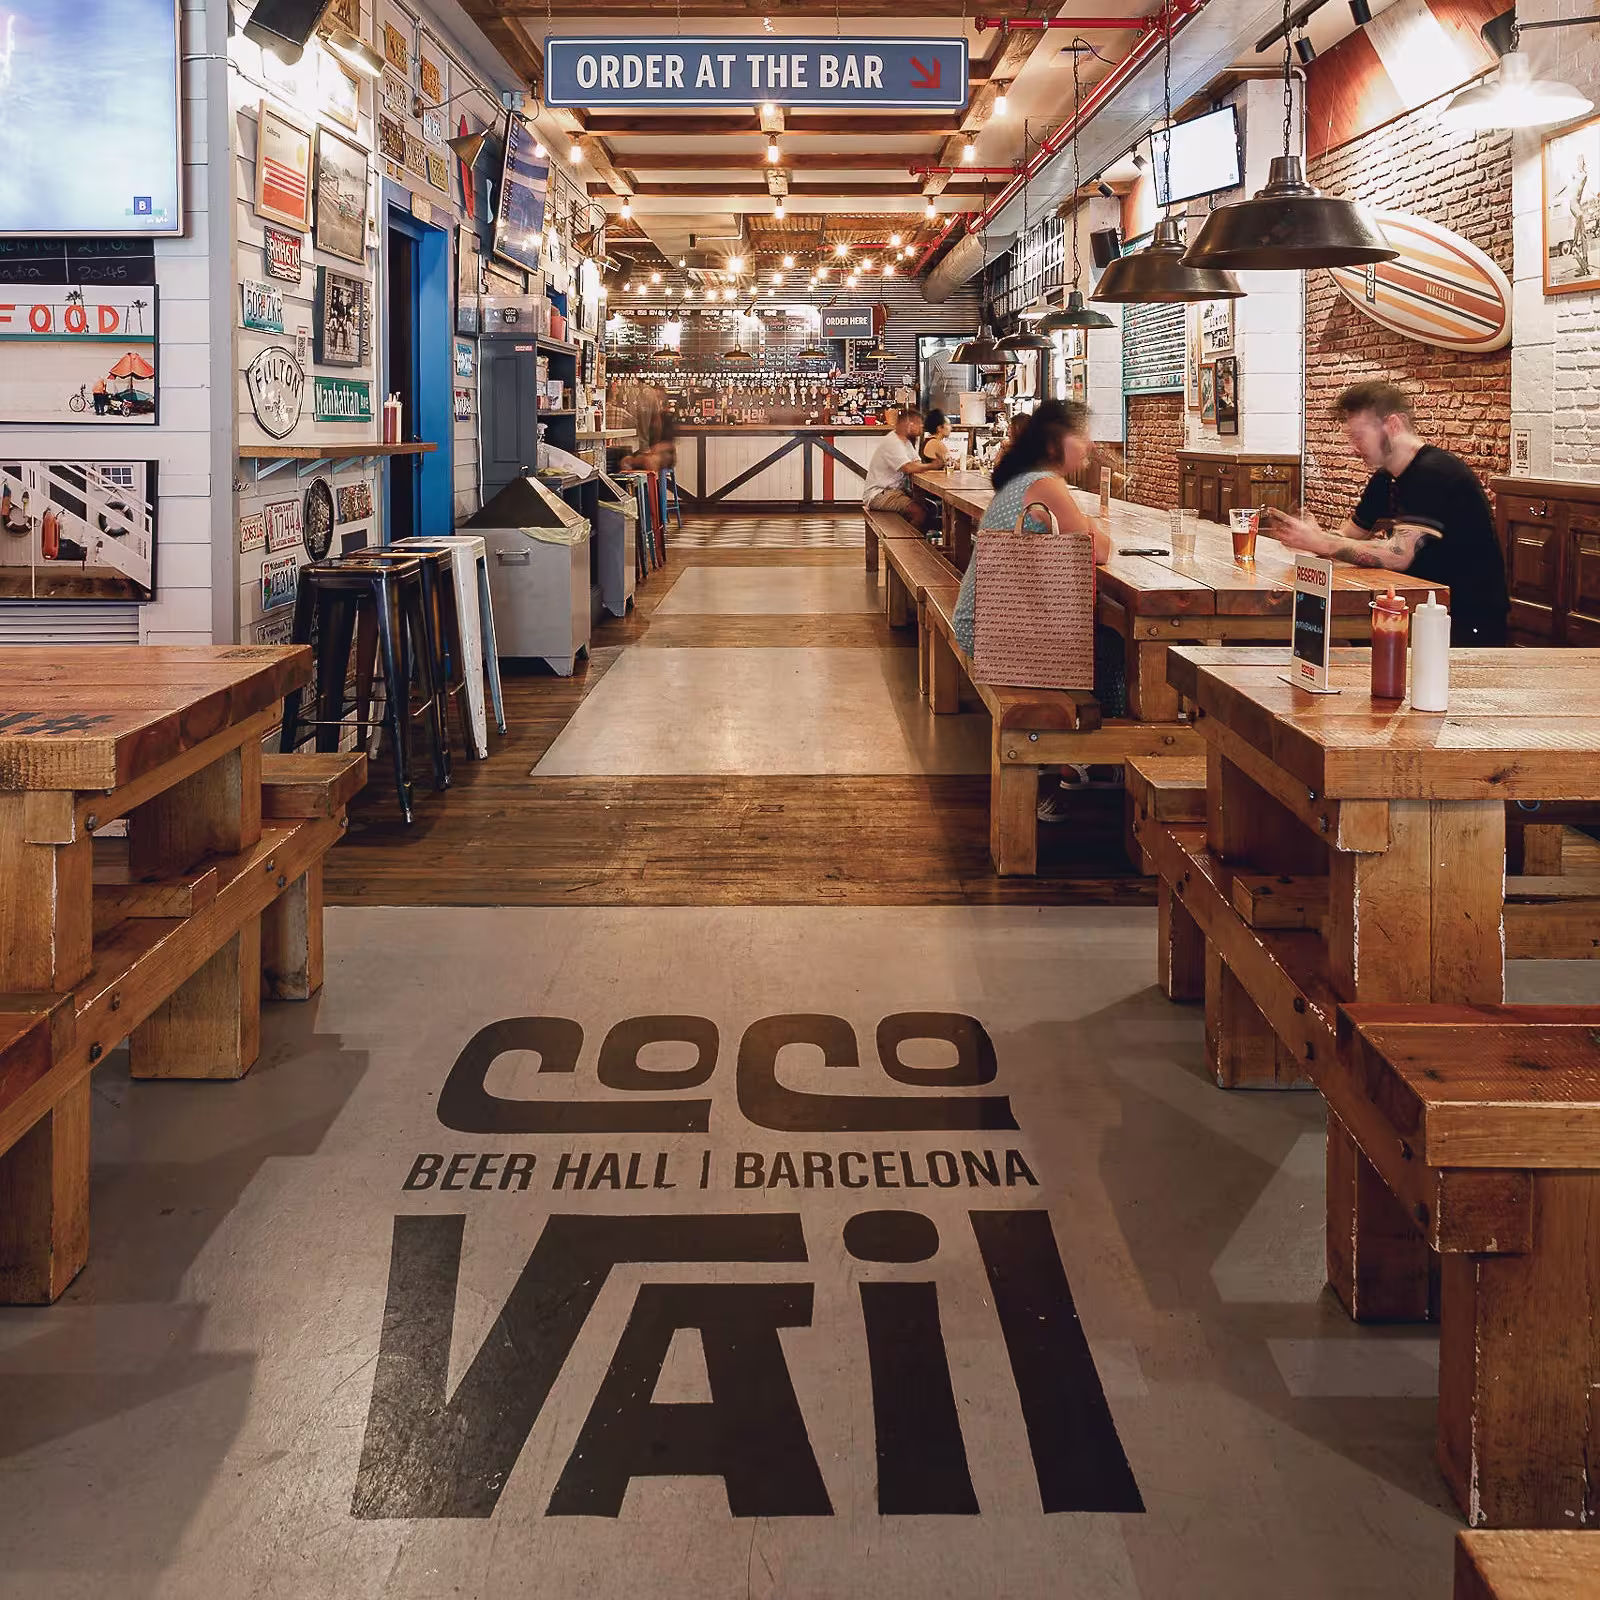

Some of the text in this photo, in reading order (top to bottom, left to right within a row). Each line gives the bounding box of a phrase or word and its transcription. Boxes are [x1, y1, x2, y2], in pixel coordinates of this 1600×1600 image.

[576, 54, 884, 89] ORDER AT THE BAR
[0, 304, 120, 334] FOOD
[825, 316, 868, 326] ORDER HERE
[255, 358, 300, 398] FULTON
[316, 382, 360, 415] Manhattan
[1297, 565, 1327, 587] RESERVED
[402, 1151, 535, 1191] BEER
[552, 1151, 676, 1190] HALL
[734, 1148, 1040, 1189] BARCELONA
